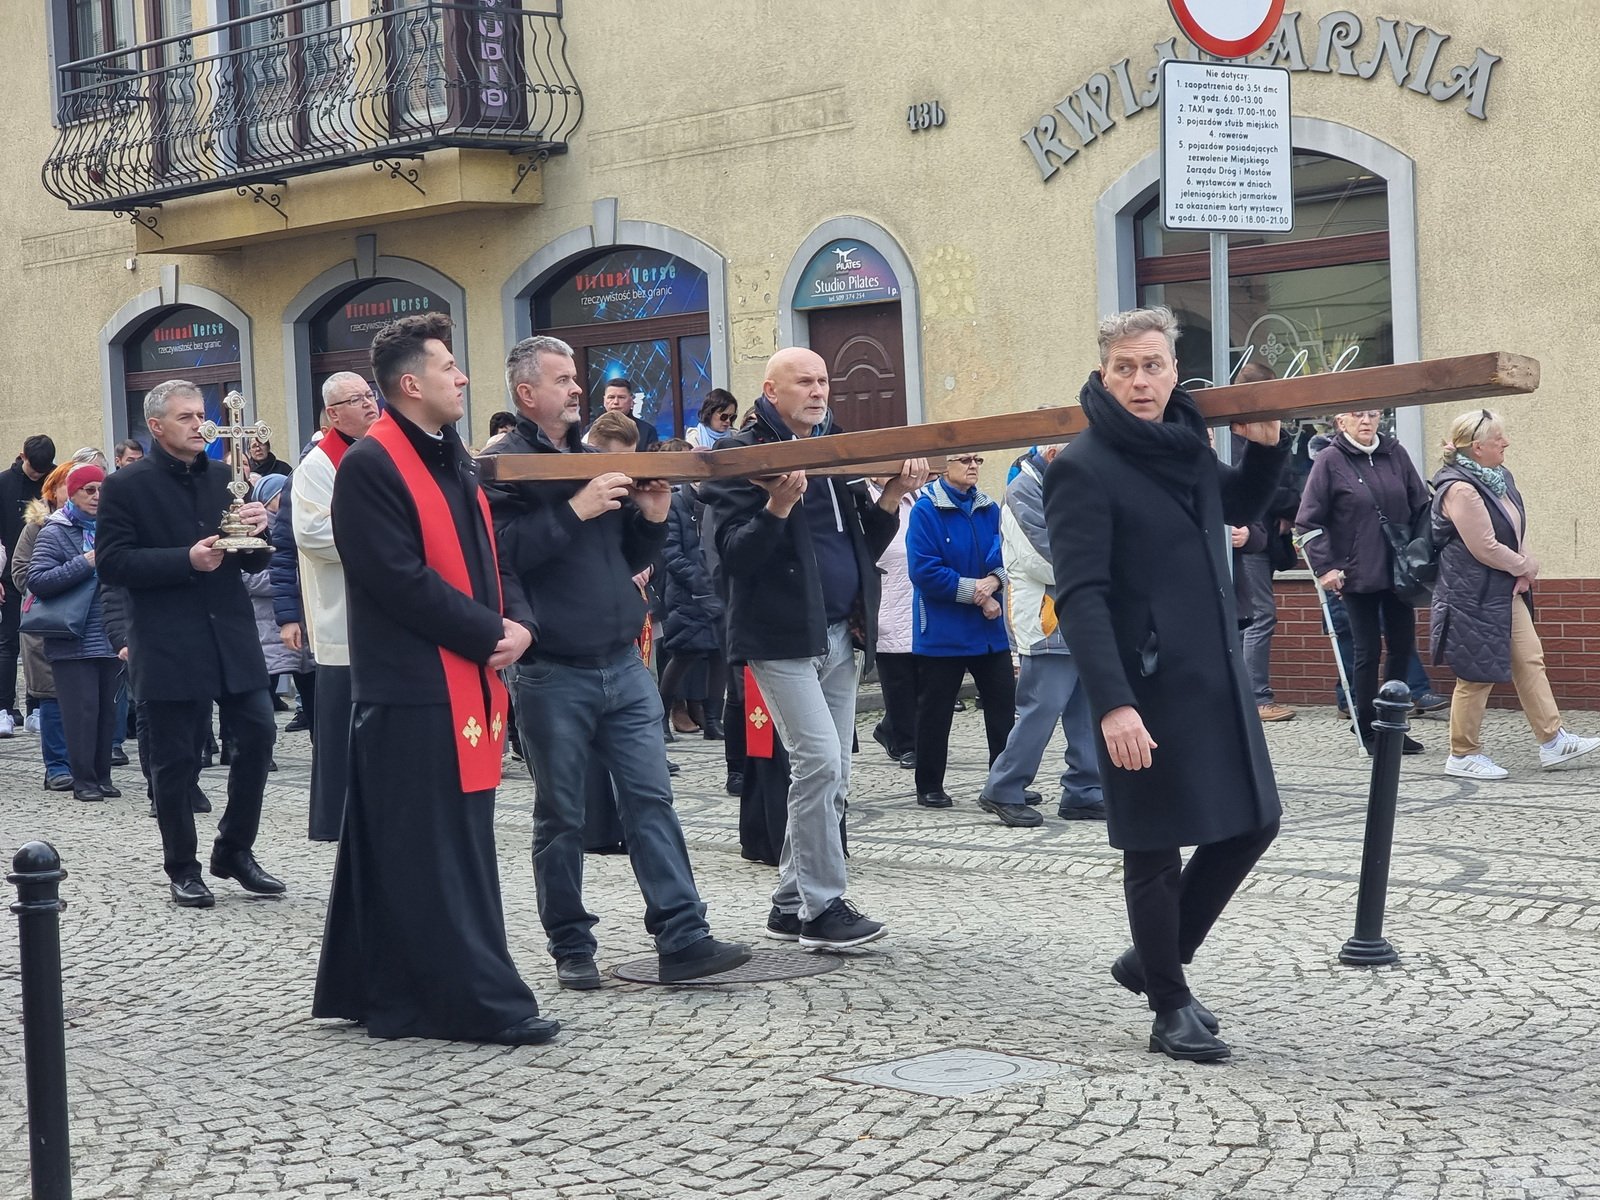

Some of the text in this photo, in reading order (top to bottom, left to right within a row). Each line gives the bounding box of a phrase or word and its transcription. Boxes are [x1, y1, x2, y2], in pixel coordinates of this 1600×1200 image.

[1206, 69, 1249, 80] Nie dotyczy:
[1185, 82, 1232, 91] zaopatrzenia
[1235, 83, 1244, 91] do
[1263, 85, 1278, 93] dmc
[1201, 94, 1220, 103] godz.
[1224, 94, 1263, 105] 6.00-13.00
[907, 101, 945, 131] 43b
[1179, 104, 1186, 112] 2.
[1188, 105, 1205, 113] TAXI
[1216, 107, 1235, 117] godz.
[1237, 108, 1277, 117] 17.00-11.00
[1177, 116, 1279, 130] 3. pojazdów służb miejskich
[1209, 130, 1248, 139] 4. rowerów
[1179, 140, 1278, 154] 5. pojazdów posiadających
[1188, 154, 1270, 166] zezwolenie Miejskiego
[1187, 165, 1216, 175] Zarządu
[1219, 166, 1237, 177] Dróg
[1244, 168, 1272, 176] Mostów
[1186, 178, 1193, 186] 6.
[1196, 179, 1236, 188] wystawców
[1247, 180, 1272, 188] dniach
[1180, 190, 1278, 201] jeleniogórskich jarmarków
[1186, 202, 1226, 210] okazaniem
[1229, 203, 1247, 213] karty
[1250, 205, 1283, 214] wystawcy
[1178, 214, 1198, 223] godz.
[1201, 214, 1239, 223] 6.00-9.00
[1246, 216, 1289, 224] 18.00-21.00
[836, 260, 861, 270] PILATES
[576, 265, 676, 291] VirtualVerse
[815, 275, 879, 294] Studio Pilates
[581, 286, 673, 305] rzeczywistość bez granic
[193, 341, 203, 350] bez
[204, 339, 222, 351] granic
